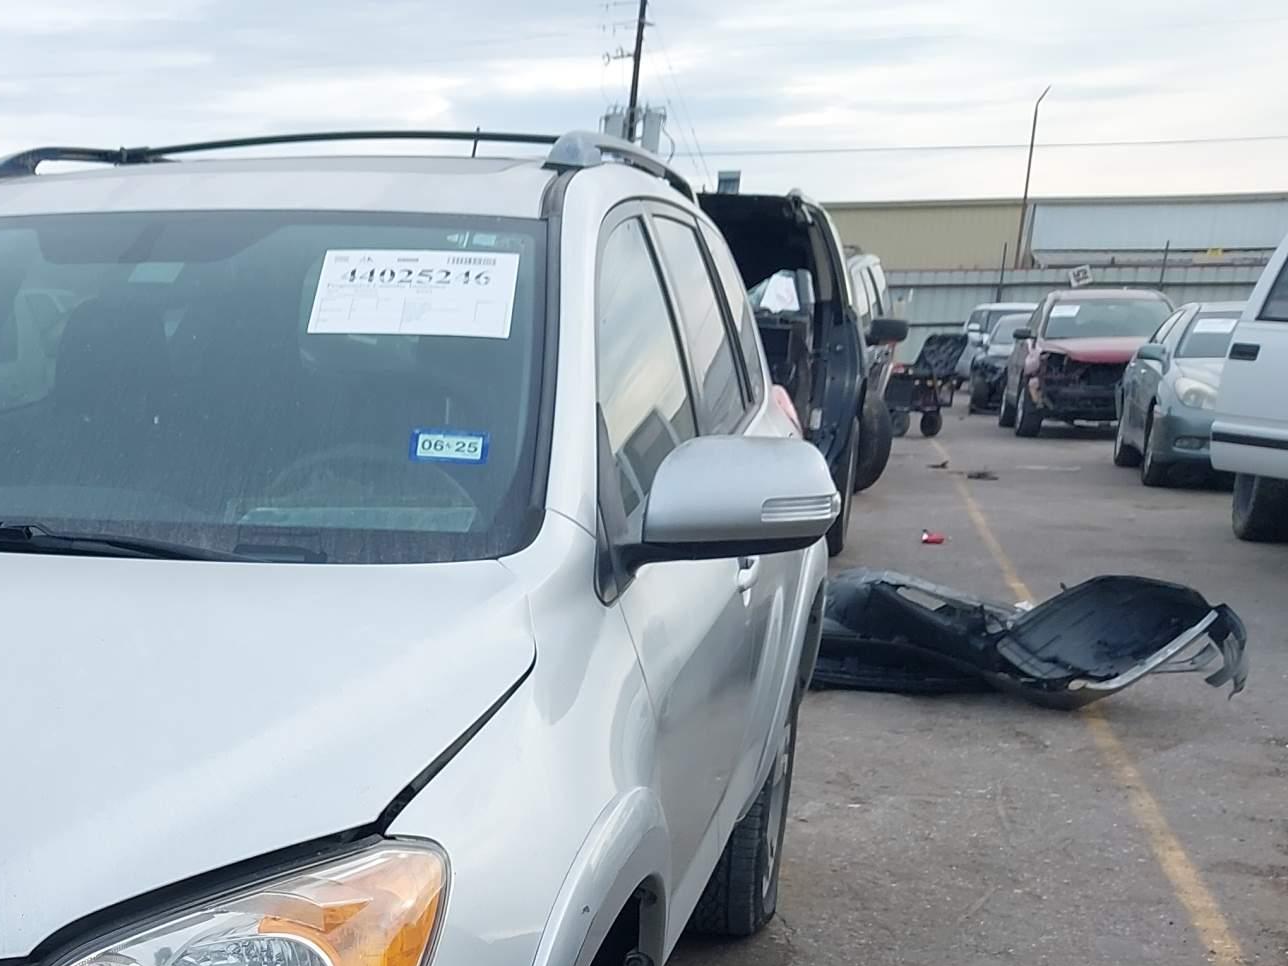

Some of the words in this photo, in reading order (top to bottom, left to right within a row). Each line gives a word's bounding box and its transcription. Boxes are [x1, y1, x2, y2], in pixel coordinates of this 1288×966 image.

[341, 267, 490, 286] 44025246
[421, 438, 444, 452] 06
[454, 440, 478, 454] 25
